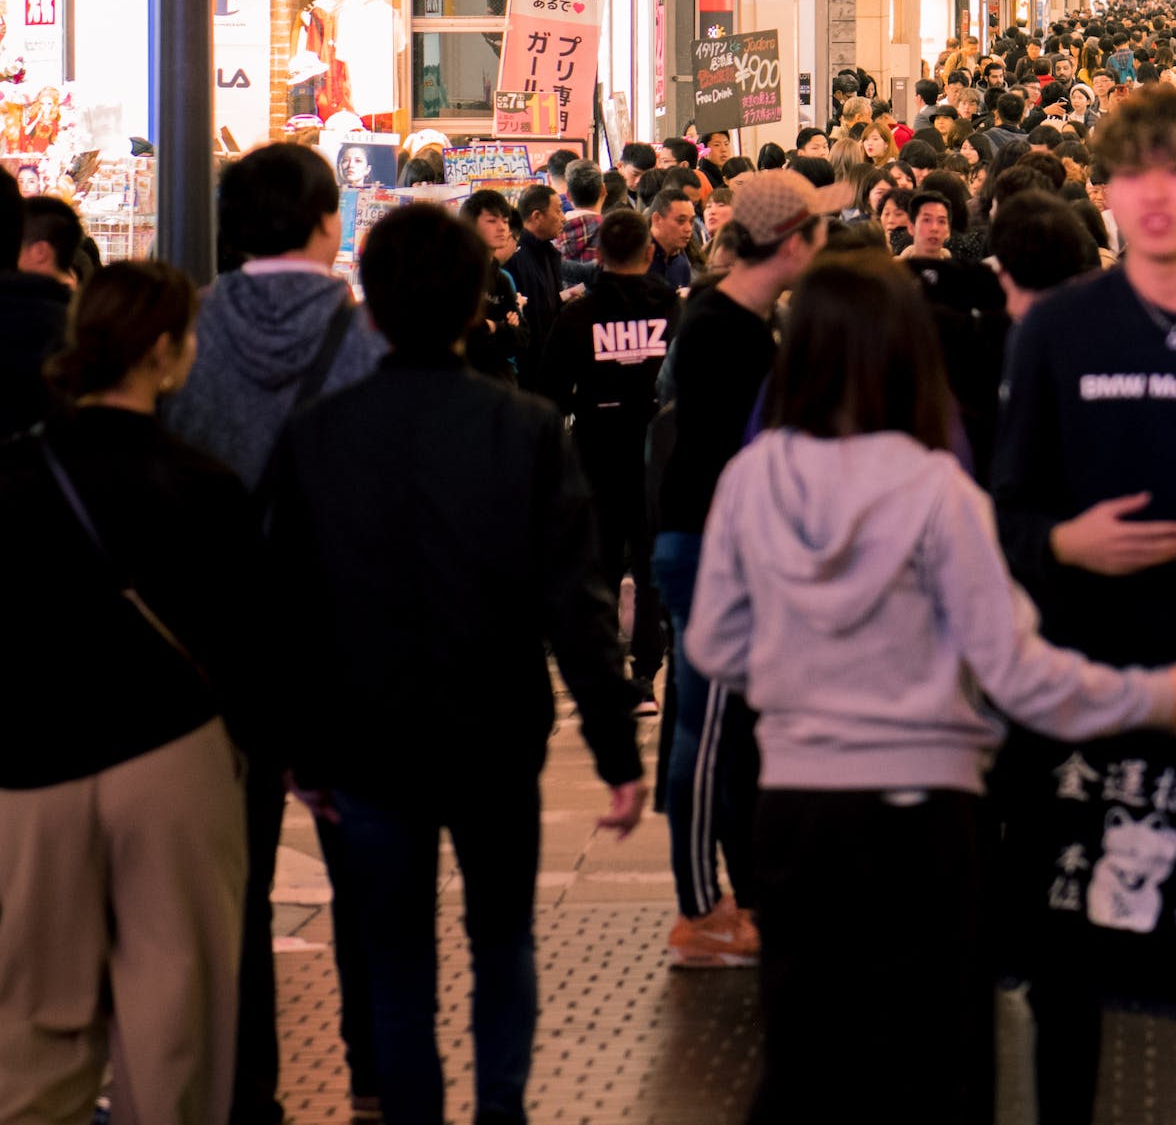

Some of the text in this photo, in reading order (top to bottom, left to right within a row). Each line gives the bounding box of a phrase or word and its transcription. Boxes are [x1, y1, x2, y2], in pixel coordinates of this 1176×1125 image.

[217, 68, 251, 89] LA
[524, 31, 552, 92] ガール
[734, 53, 780, 93] ¥900
[507, 93, 517, 109] 7
[526, 93, 557, 134] 11
[592, 318, 667, 353] NHIZ
[1080, 373, 1147, 401] BMW
